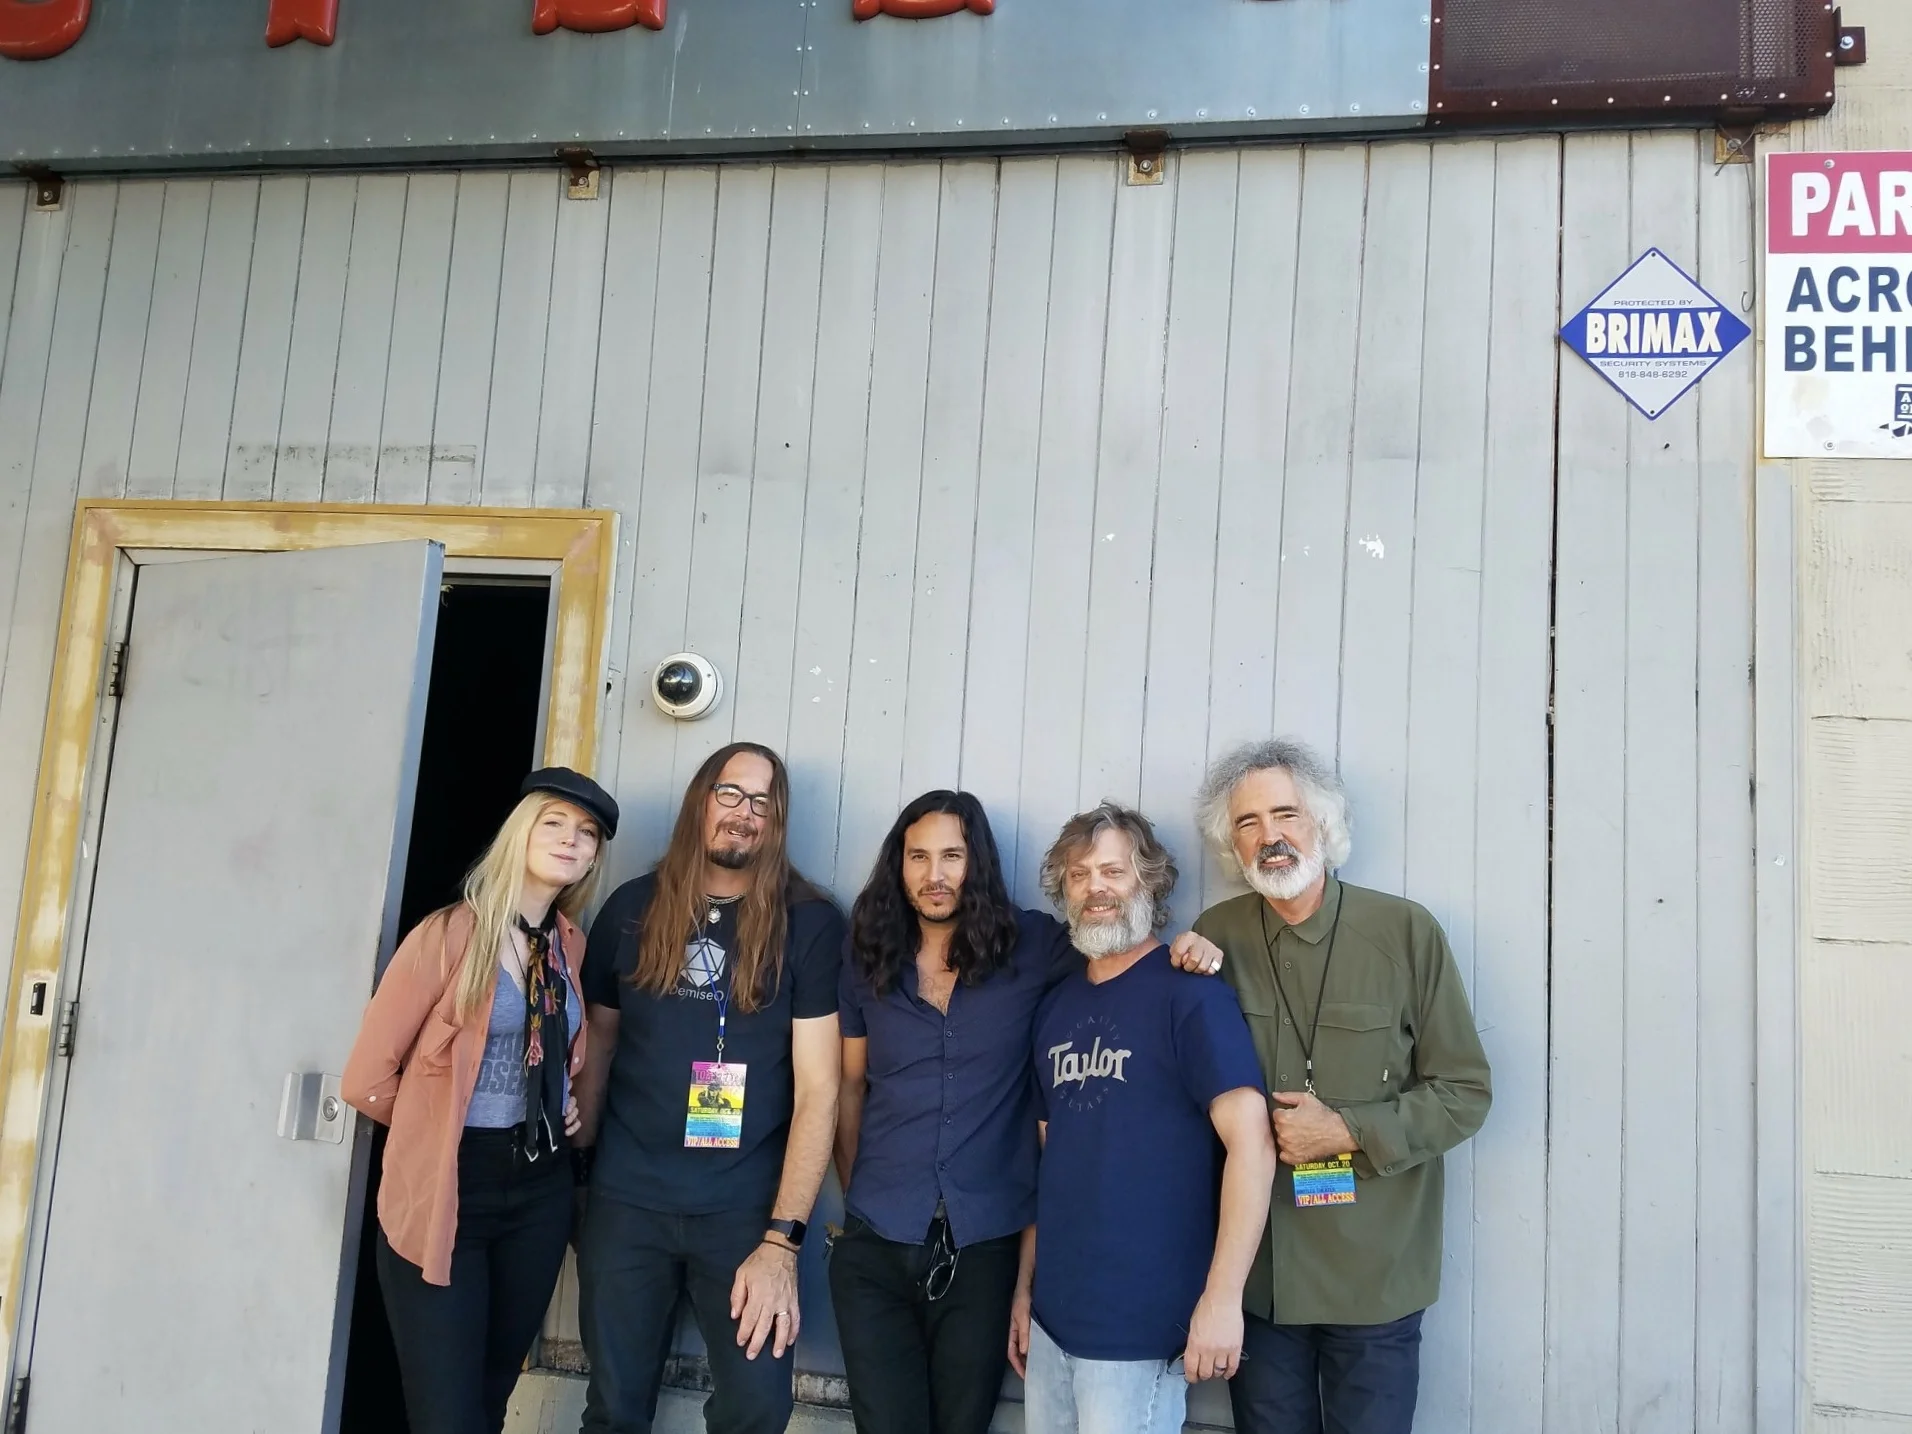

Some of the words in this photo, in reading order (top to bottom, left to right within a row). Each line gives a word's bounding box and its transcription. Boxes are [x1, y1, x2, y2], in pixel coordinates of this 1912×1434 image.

[1786, 265, 1912, 313] ACR
[1586, 311, 1723, 354] BRIMAX
[1618, 370, 1688, 378] 818-848-6292
[1048, 1036, 1132, 1091] Taylor
[1295, 1162, 1325, 1170] SATURDAY
[1342, 1160, 1350, 1168] 20
[1298, 1193, 1327, 1206] VIP/ALL
[1328, 1192, 1354, 1203] ACCESS
